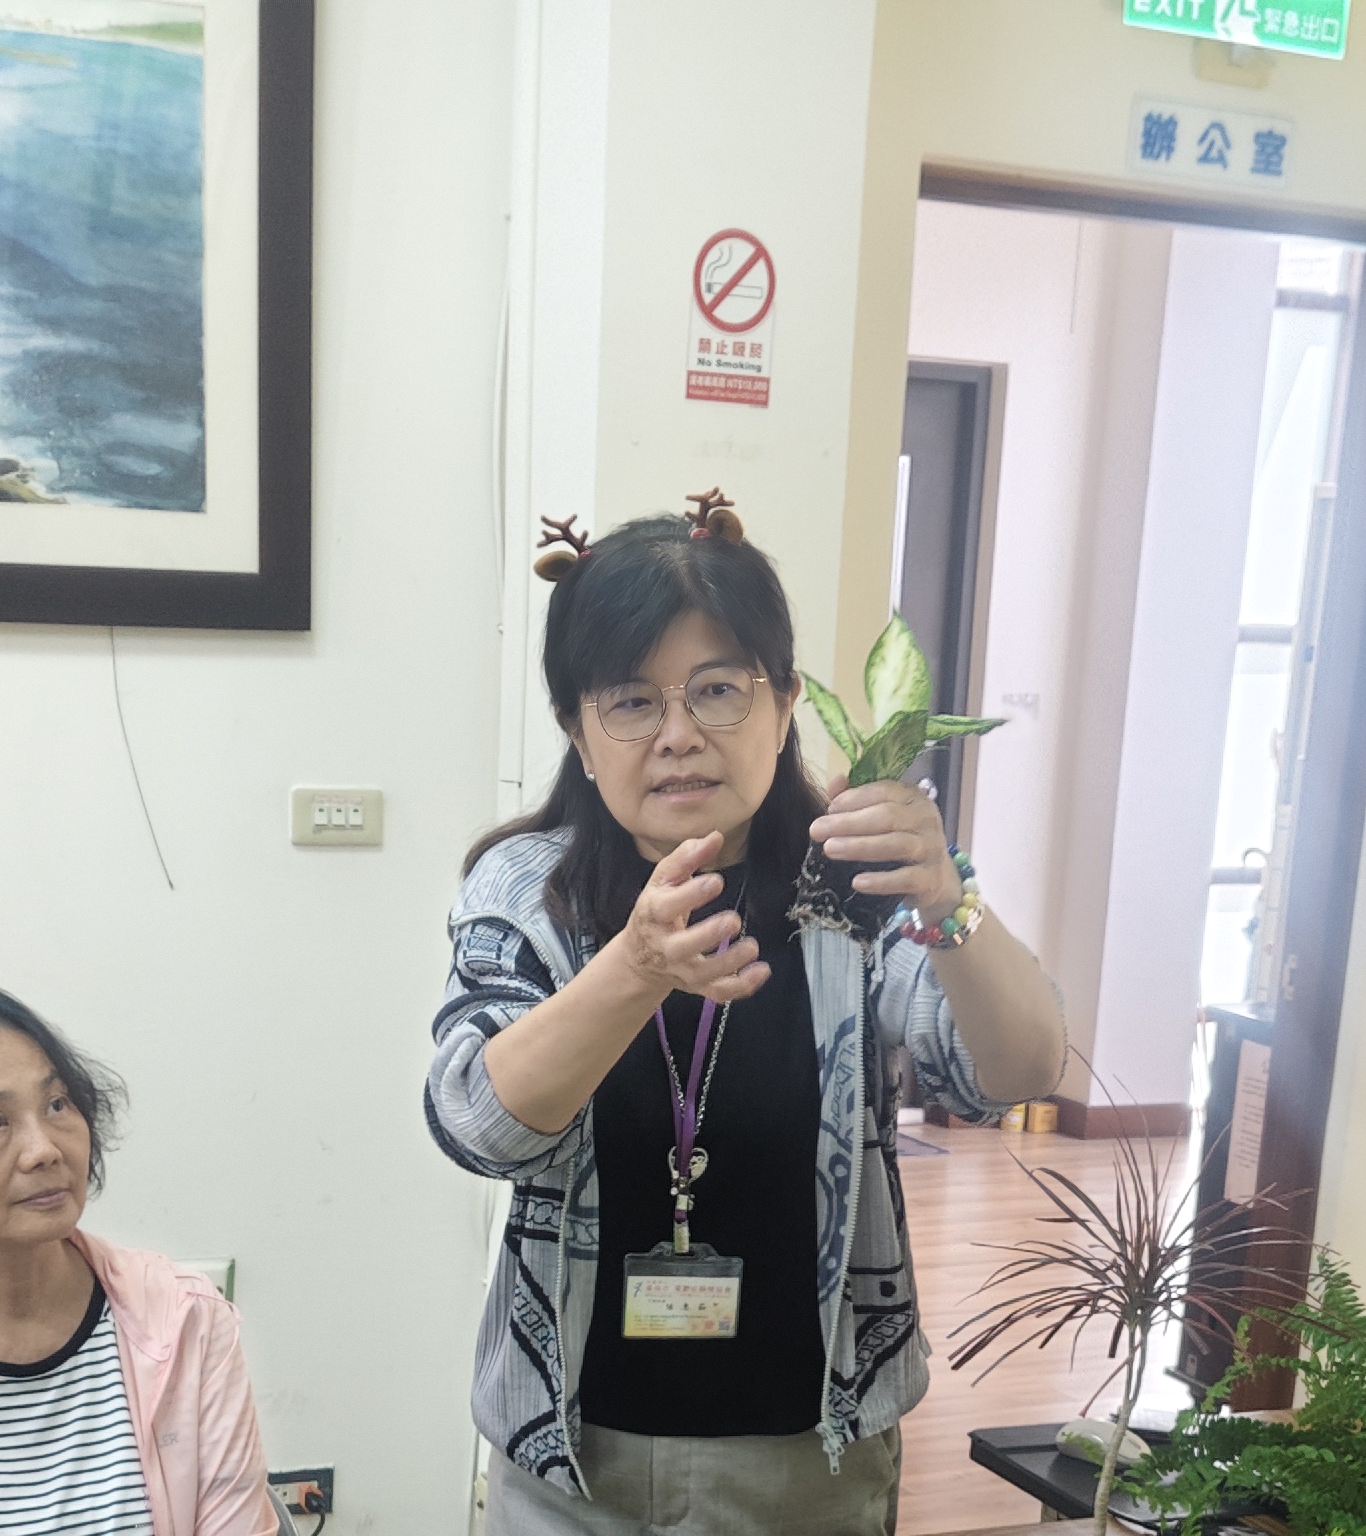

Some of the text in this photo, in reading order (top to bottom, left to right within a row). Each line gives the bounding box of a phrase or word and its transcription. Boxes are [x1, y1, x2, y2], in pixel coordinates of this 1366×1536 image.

[1264, 7, 1340, 43] 緊急出口
[1140, 109, 1287, 177] 辦公室
